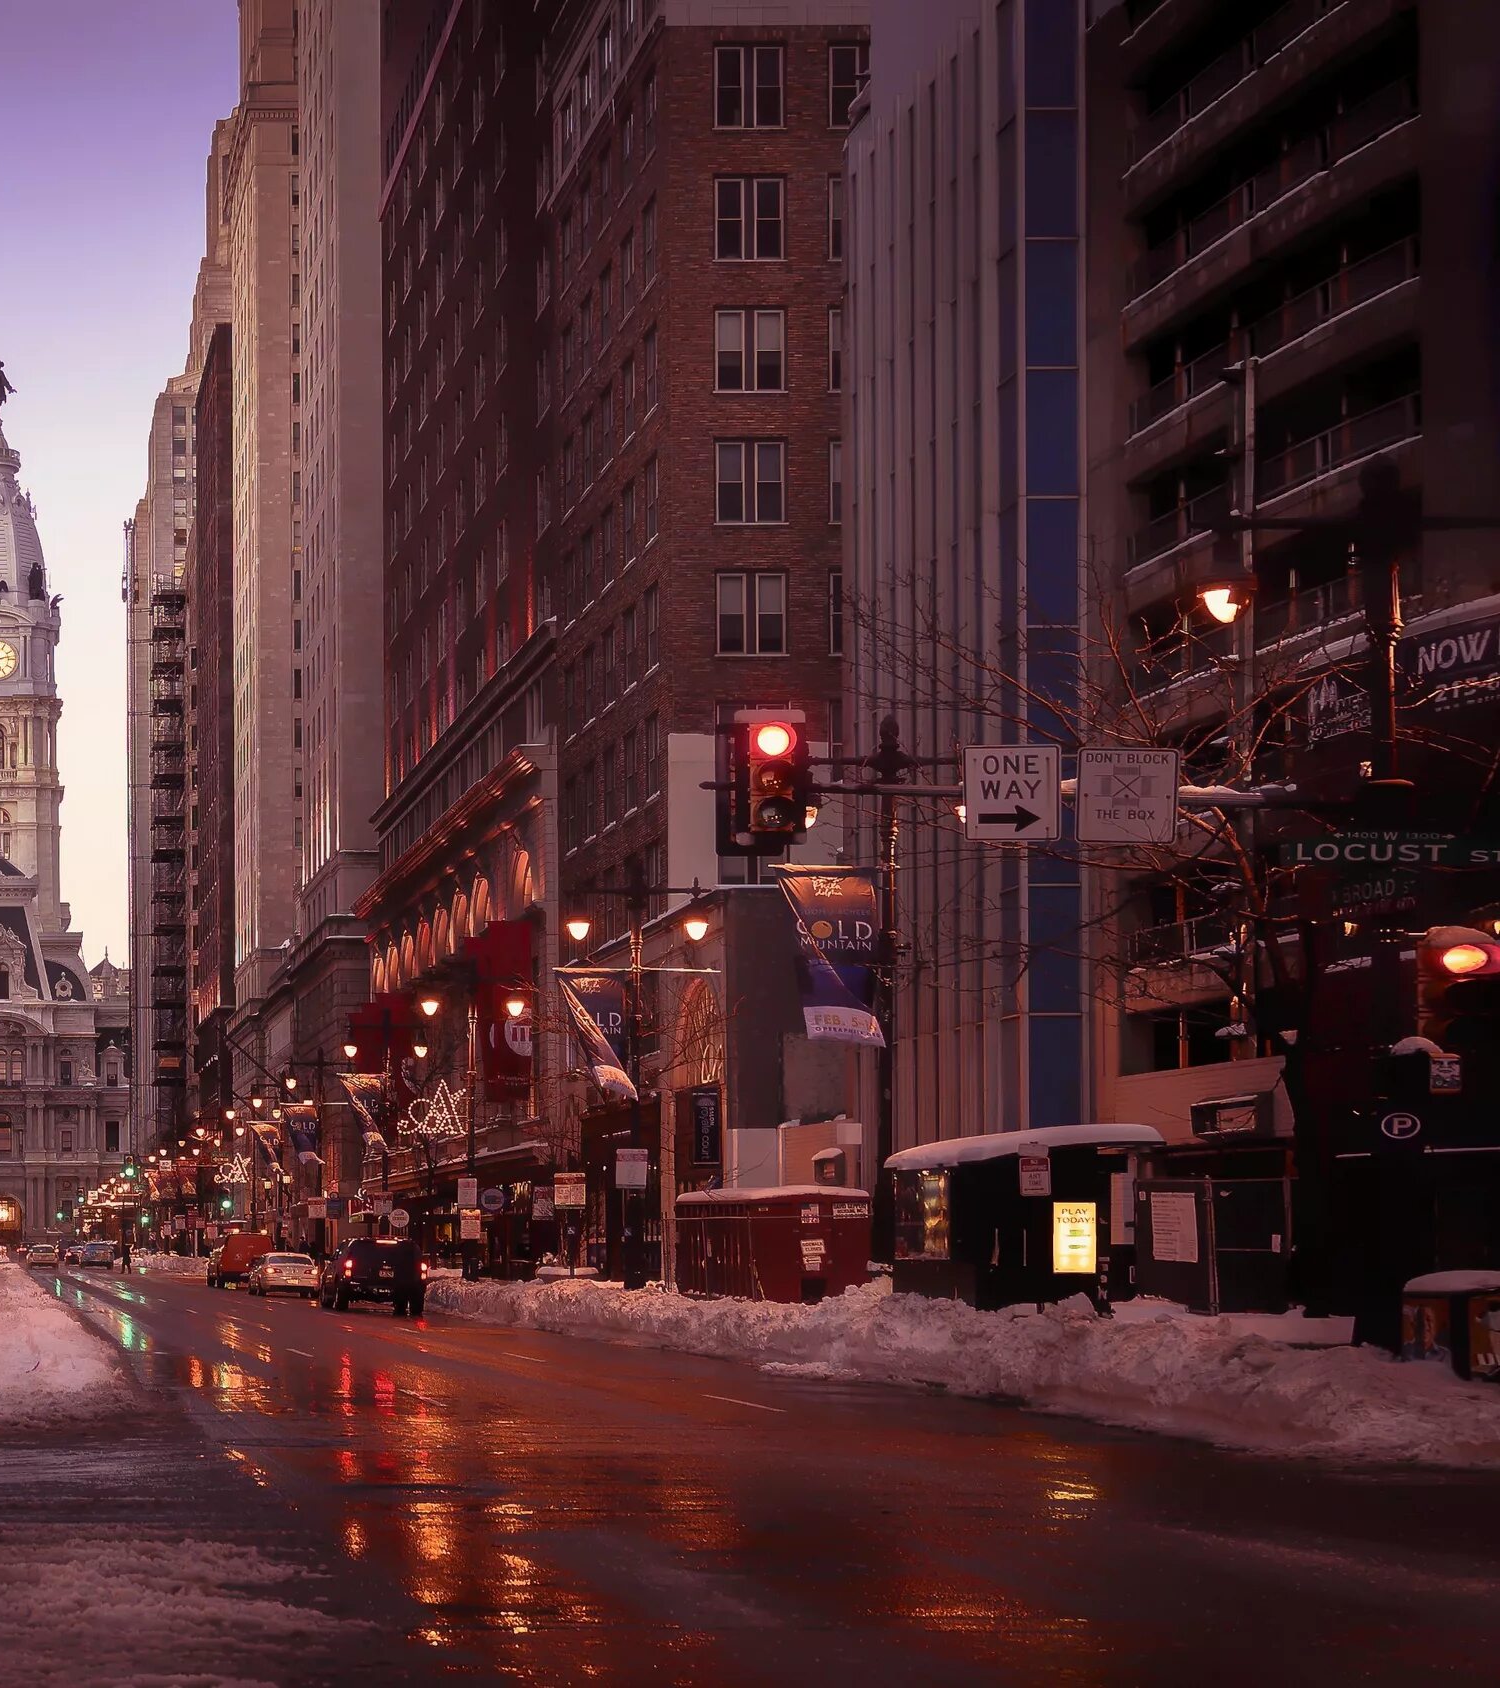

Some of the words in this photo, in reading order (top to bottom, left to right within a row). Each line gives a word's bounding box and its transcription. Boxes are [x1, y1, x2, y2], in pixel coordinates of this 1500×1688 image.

[1418, 629, 1492, 675] NOW
[982, 755, 1040, 775] ONE
[1127, 753, 1169, 764] BLOCK
[980, 780, 1042, 800] WAY
[1095, 809, 1120, 820] THE
[1127, 809, 1155, 820] BOX
[1347, 831, 1378, 840] 1400
[1383, 831, 1399, 841] W
[1406, 832, 1440, 840] 1300
[1296, 842, 1448, 862] LOCUST
[1343, 878, 1396, 904] BROAD
[1392, 1117, 1412, 1135] P
[701, 1136, 710, 1161] court
[1057, 1217, 1095, 1225] TODAY!
[1061, 1208, 1089, 1216] PLAY
